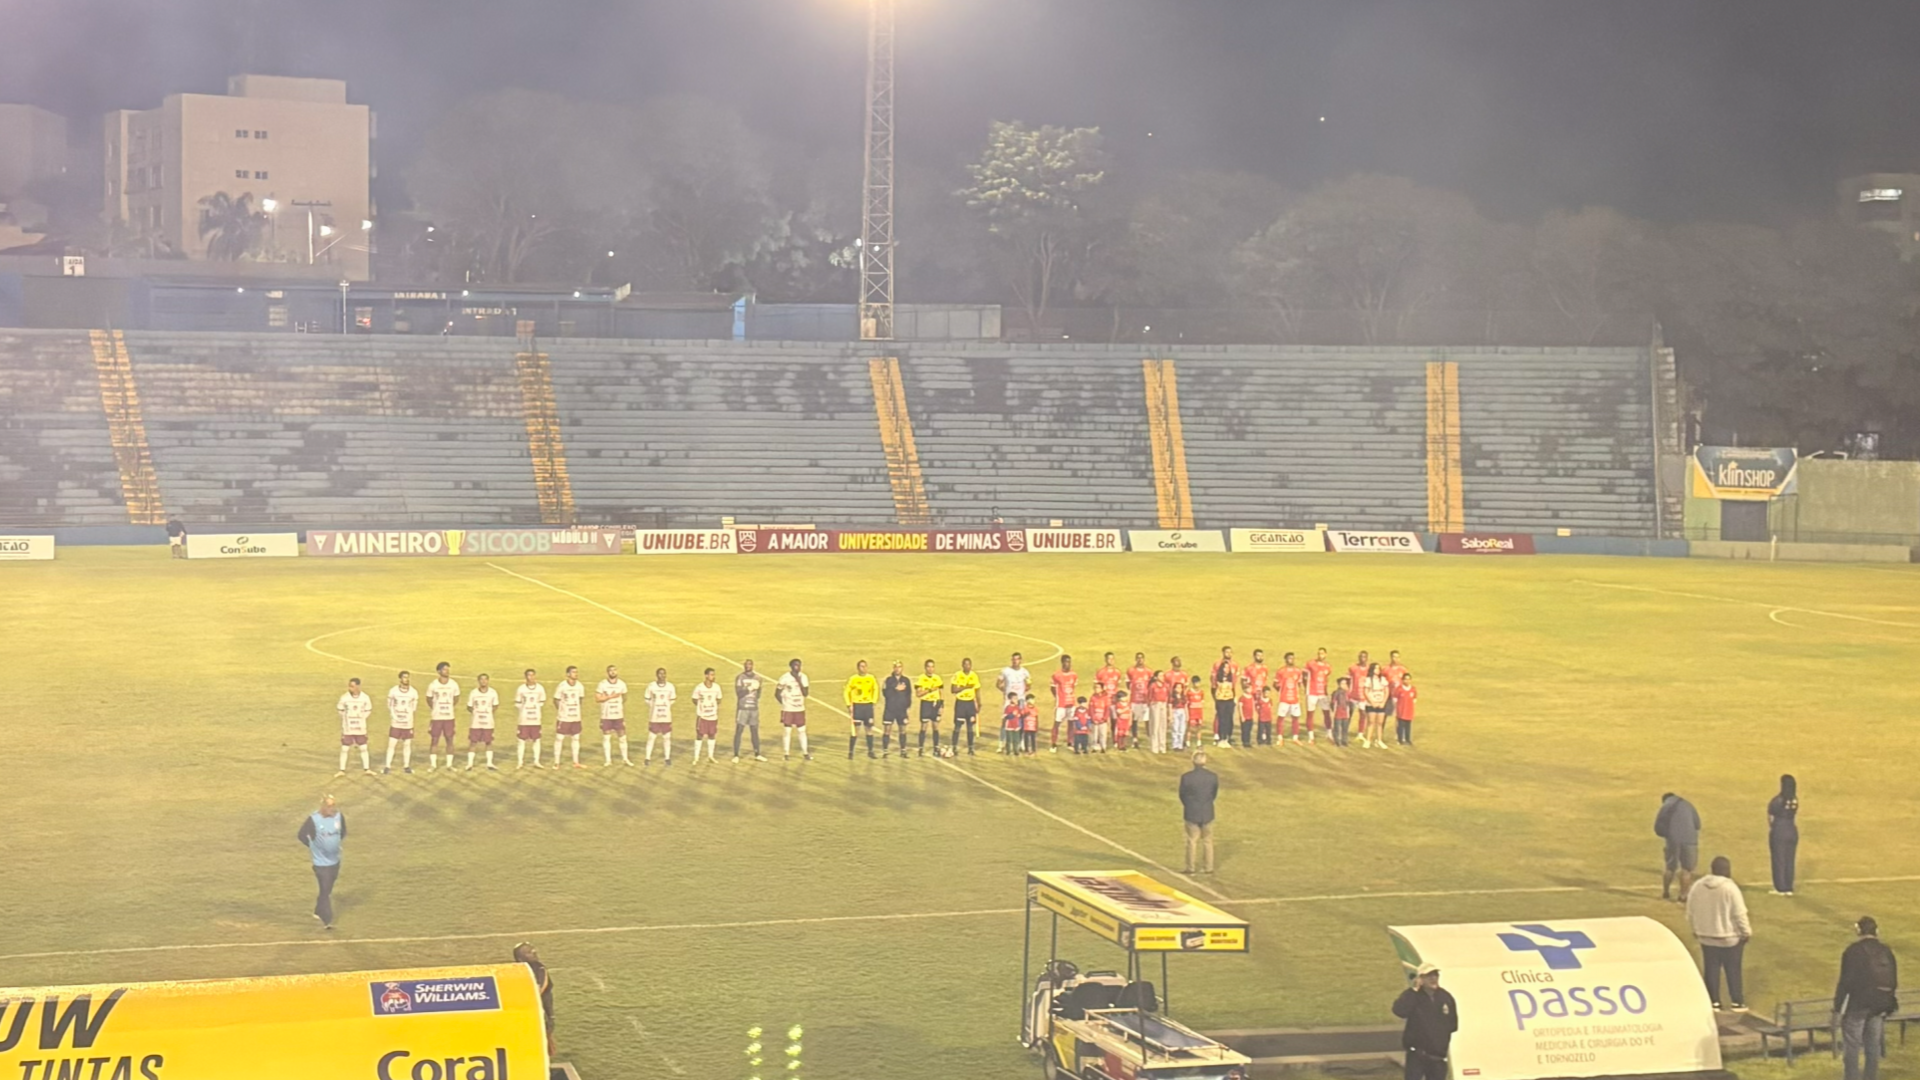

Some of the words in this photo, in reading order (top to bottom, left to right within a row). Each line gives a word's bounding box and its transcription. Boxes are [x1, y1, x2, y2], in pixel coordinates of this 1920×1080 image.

[334, 532, 442, 554] MINEIRO
[466, 532, 551, 552] SICOOB
[642, 533, 730, 550] UNIUBE.BR
[767, 533, 779, 550] A
[781, 532, 828, 550] MAIOR
[838, 532, 928, 551] UNIVERSIDADE
[936, 533, 954, 550] DE
[956, 532, 1001, 550] MINAS
[1032, 532, 1115, 549] UNIUBE.BR
[1338, 532, 1410, 547] Terrare
[1501, 969, 1554, 984] Clínica
[415, 982, 485, 993] SHERWIN
[1508, 984, 1647, 1031] passo
[1533, 1026, 1582, 1038] ORTOPEDIA
[1584, 1026, 1589, 1035] E
[1592, 1023, 1664, 1035] TRAUMATOLOGIA
[1535, 1039, 1578, 1051] MEDICINA
[1580, 1039, 1585, 1048] E
[1587, 1037, 1628, 1049] CIRURGIA
[1630, 1037, 1642, 1047] DO
[377, 1048, 508, 1080] Coral
[1537, 1054, 1543, 1064] E
[1545, 1052, 1596, 1064] TORNOZELO
[19, 1054, 163, 1080] TINTAS
